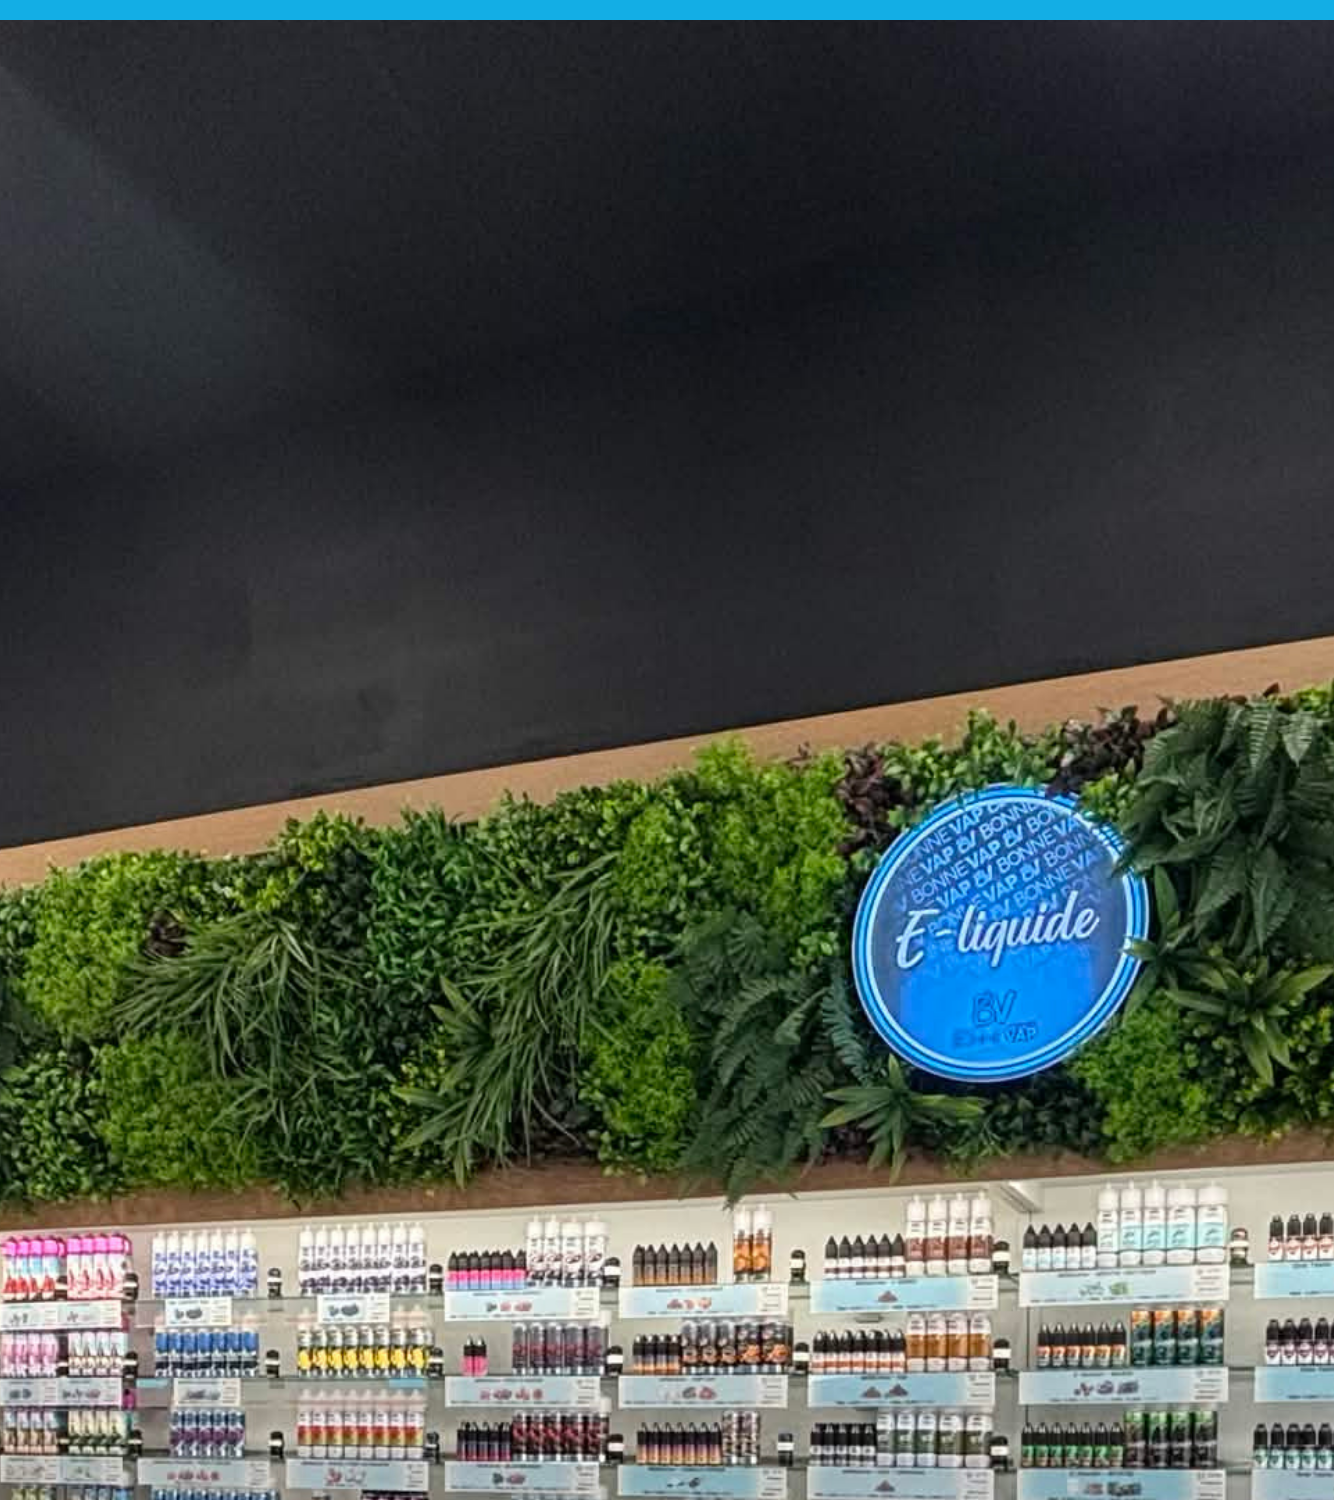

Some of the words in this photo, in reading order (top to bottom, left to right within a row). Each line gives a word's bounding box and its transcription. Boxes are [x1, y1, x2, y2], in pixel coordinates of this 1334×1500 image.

[911, 860, 968, 904] BONNE
[967, 840, 1001, 868] VAP
[921, 846, 954, 874] VAP
[936, 881, 971, 909] VAP
[996, 829, 1056, 873] BONNE
[983, 874, 1017, 902] VAP
[896, 890, 1100, 968] E-liquide
